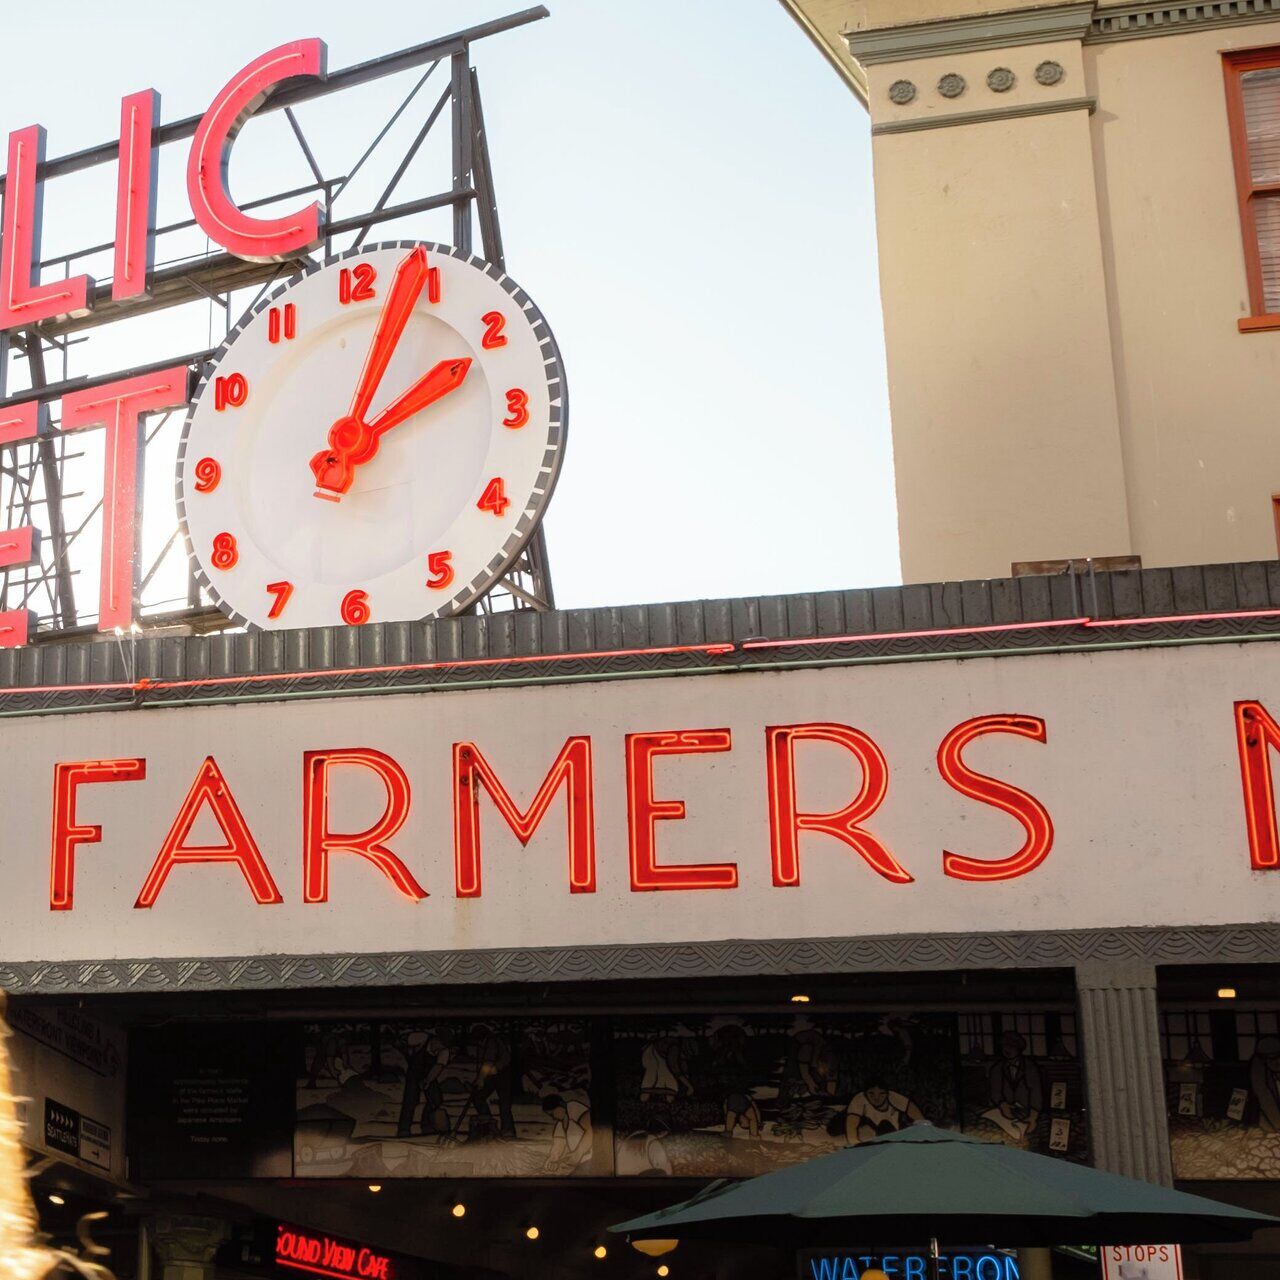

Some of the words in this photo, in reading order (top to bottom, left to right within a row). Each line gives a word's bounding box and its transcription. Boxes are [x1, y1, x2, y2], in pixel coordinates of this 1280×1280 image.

[339, 263, 377, 304] 12
[428, 266, 441, 304] 1
[268, 303, 296, 344] 11
[481, 312, 508, 350] 2
[214, 372, 249, 411] 10
[502, 388, 530, 429] 3
[194, 457, 222, 494] 9
[476, 477, 511, 517] 4
[211, 532, 239, 570] 8
[426, 551, 454, 590] 5
[267, 581, 295, 619] 7
[340, 589, 370, 627] 6
[50, 713, 1054, 911] FARMERS
[1113, 1245, 1170, 1262] STOPS
